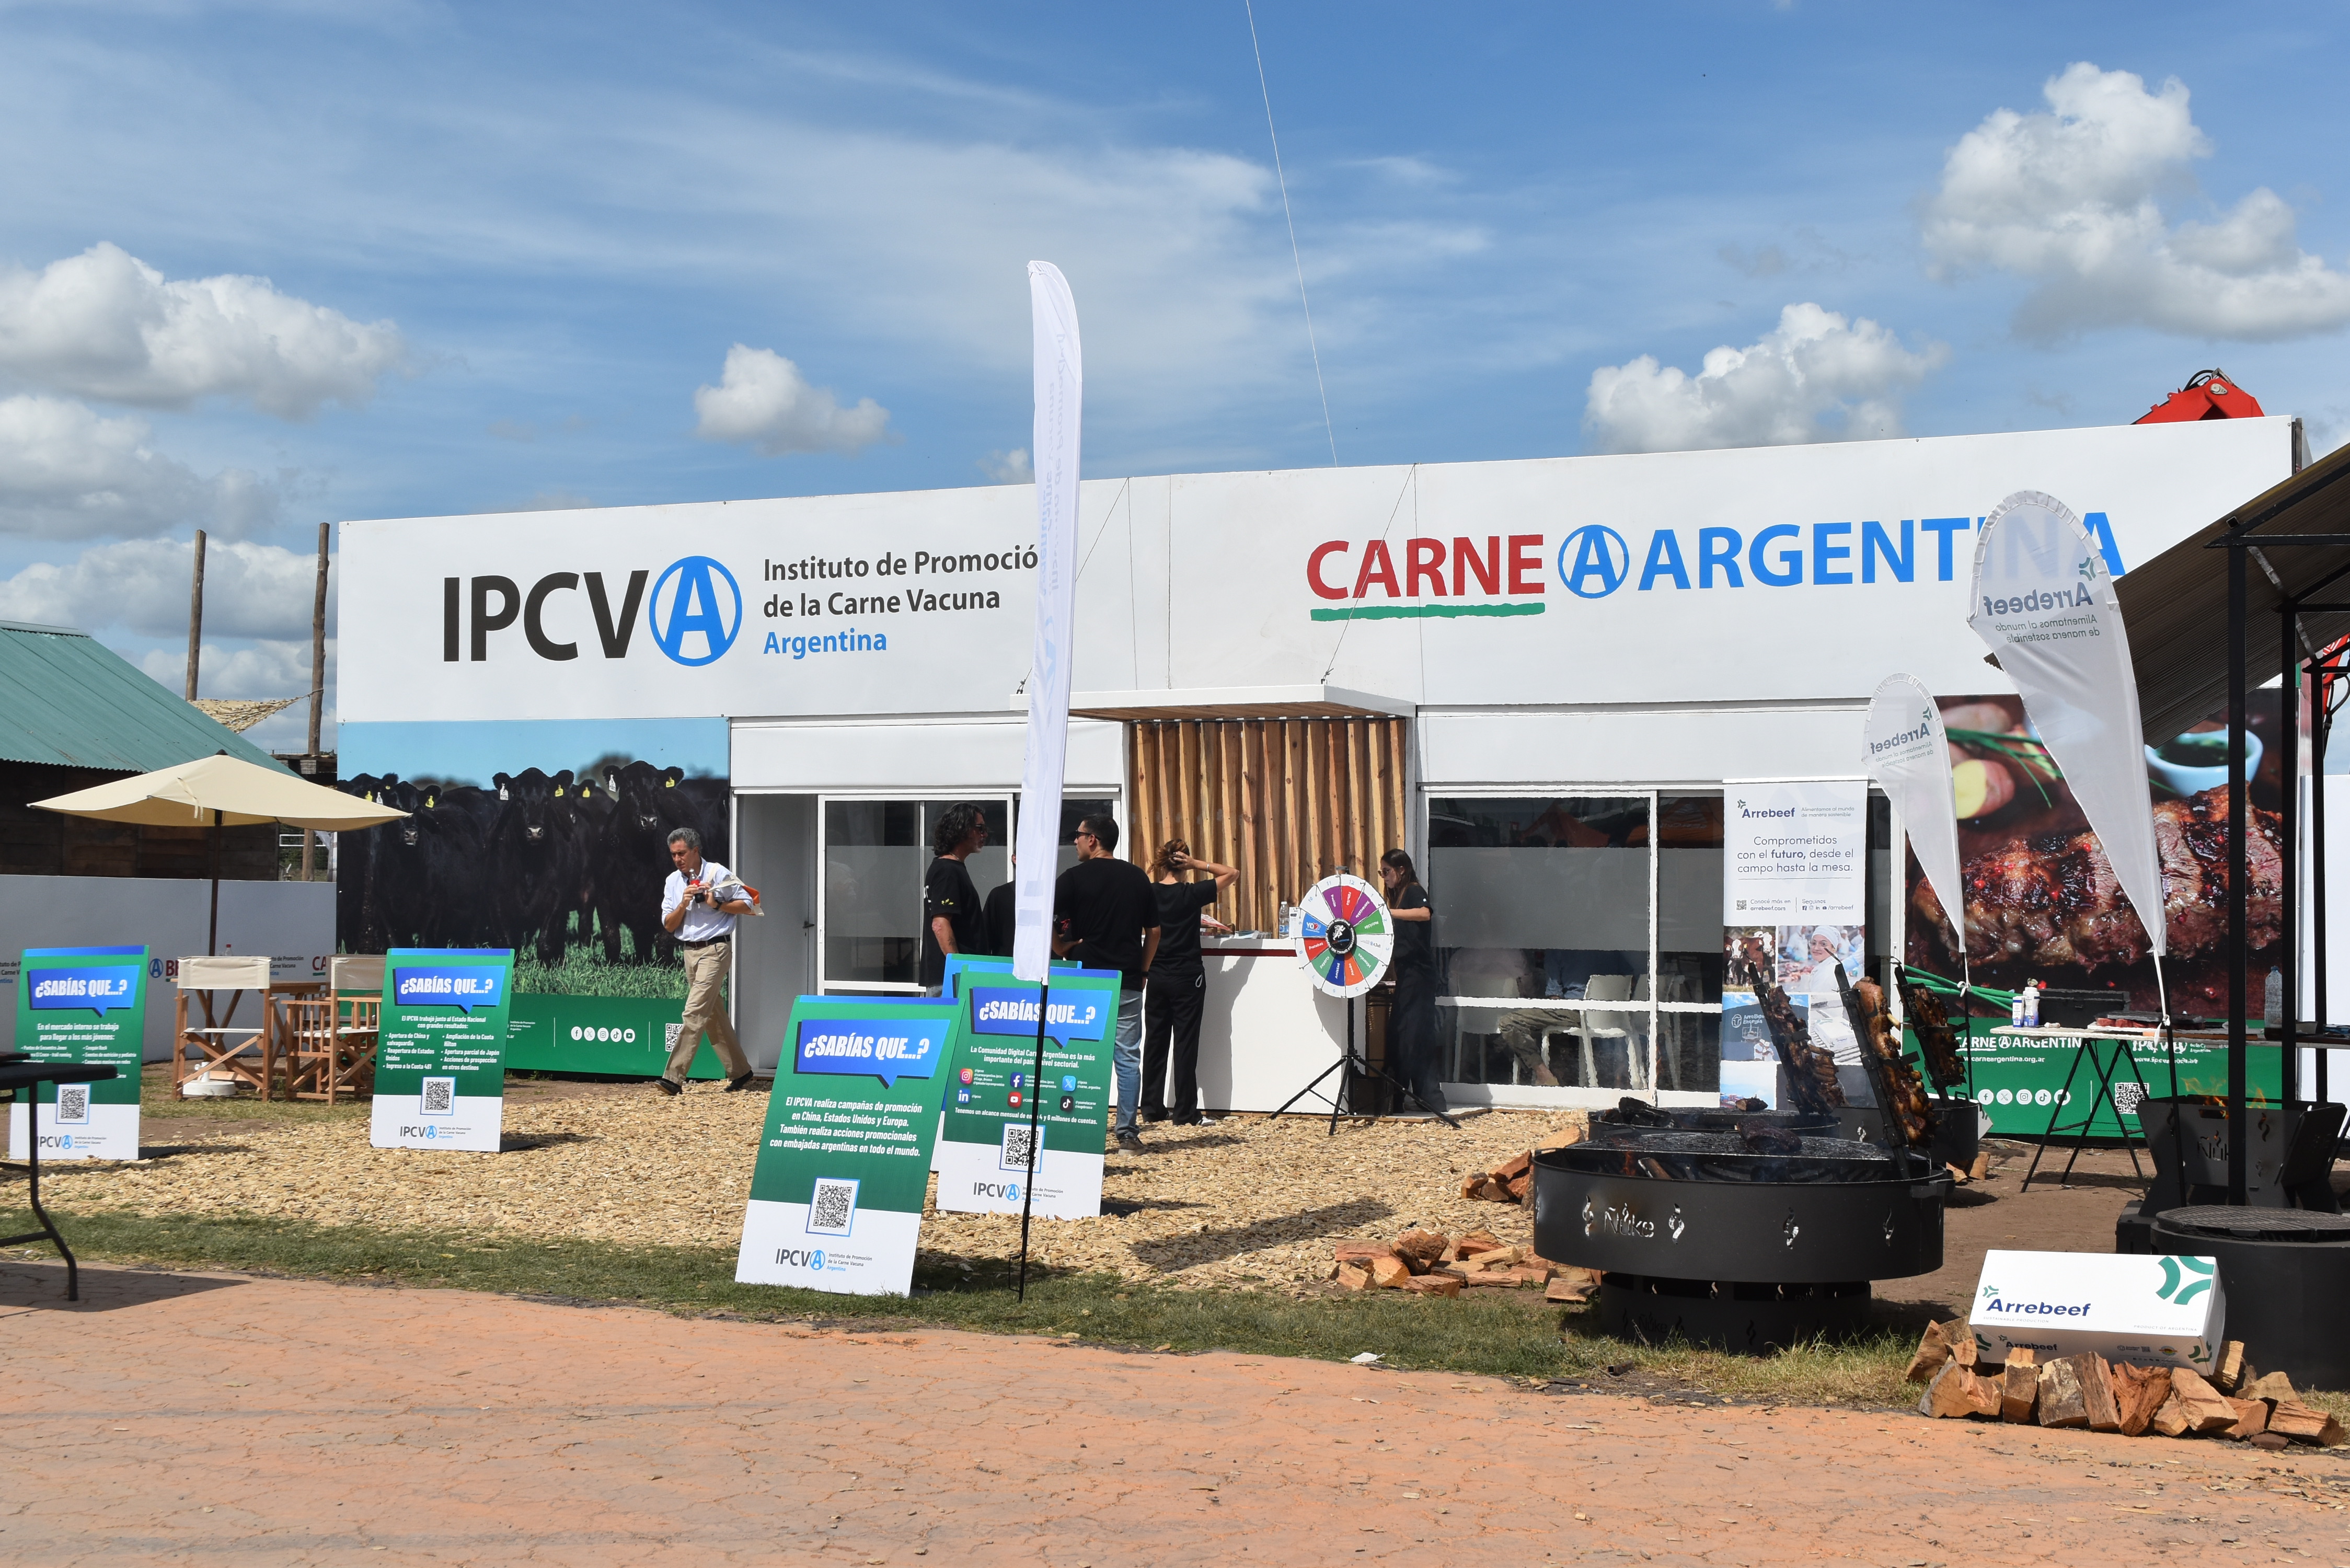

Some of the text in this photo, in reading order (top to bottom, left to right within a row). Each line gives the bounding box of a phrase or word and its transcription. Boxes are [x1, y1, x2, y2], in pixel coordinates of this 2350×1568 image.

[764, 544, 1038, 582] Instituto de Promoció
[1307, 534, 1545, 599] CARNE
[763, 587, 1000, 618] de la Carne Vacuna
[763, 630, 888, 661] Argentina
[1742, 808, 1795, 818] Arrebeef
[1754, 835, 1837, 847] Comprometidos
[1759, 849, 1767, 859] el
[1771, 849, 1806, 859] futuro,
[1810, 849, 1841, 858] desde
[1845, 848, 1853, 858] el
[1737, 864, 1773, 874] campo
[1777, 863, 1805, 872] hasta
[1809, 862, 1818, 871] la
[36, 977, 86, 998] ¿SABÍAS
[401, 976, 493, 995] ¿SABÍAS QUE...?
[980, 999, 1096, 1024] ¿SABÍAS QUE...?
[100, 1023, 119, 1031] trabaja
[93, 1033, 115, 1042] jóvenes:
[2012, 1037, 2082, 1048] ARGENTIN
[804, 1033, 929, 1060] ¿SABÍAS QUE...?
[978, 1046, 1007, 1055] Comunidad
[1008, 1048, 1025, 1057] Digital
[1042, 1051, 1068, 1060] Argentina
[984, 1055, 1012, 1064] importante
[1023, 1057, 1034, 1066] país
[1054, 1060, 1079, 1068] sectorial.
[786, 1097, 922, 1113] El IPCVA realiza campañas de promoción
[802, 1112, 822, 1123] China,
[824, 1113, 850, 1123] Estados
[853, 1114, 876, 1125] Unidos
[876, 1117, 882, 1127] y
[883, 1116, 909, 1128] Europa.
[780, 1124, 917, 1142] También realiza acciones promocionales
[40, 1135, 73, 1149] PCVA
[784, 1139, 820, 1150] embajadas
[821, 1142, 858, 1152] argentinas
[869, 1145, 885, 1154] todo
[886, 1145, 893, 1155] el
[894, 1146, 920, 1156] mundo.
[1986, 1299, 2091, 1316] Arrebeef
[2006, 1341, 2057, 1350] Arrebeef
